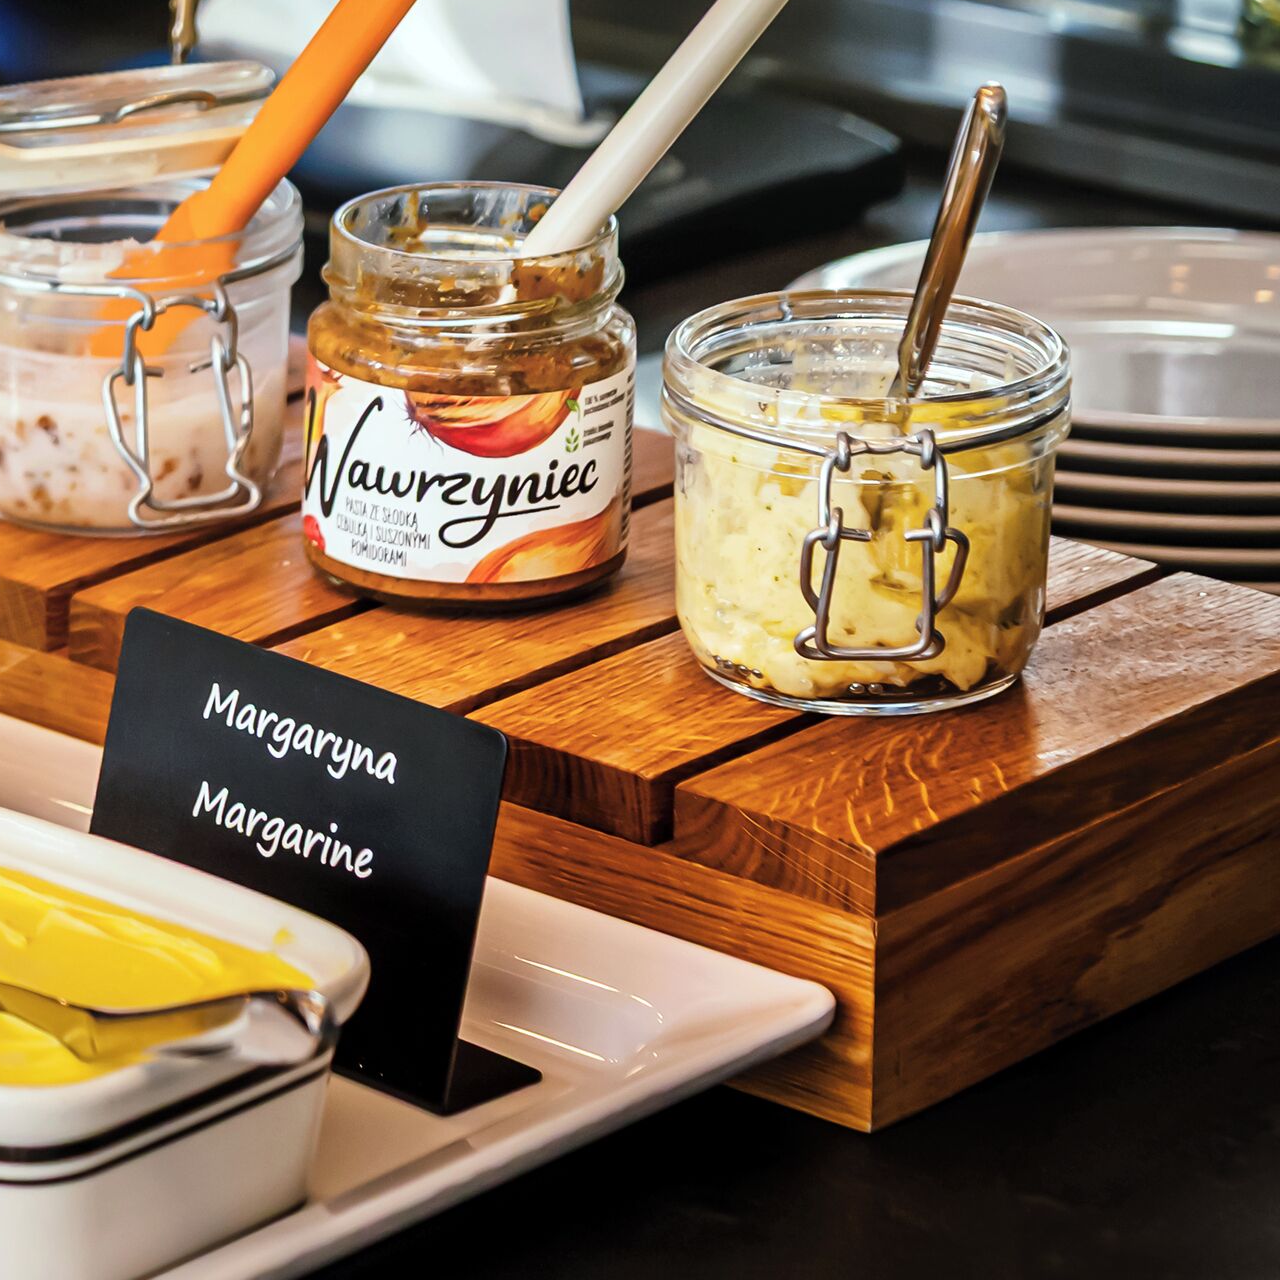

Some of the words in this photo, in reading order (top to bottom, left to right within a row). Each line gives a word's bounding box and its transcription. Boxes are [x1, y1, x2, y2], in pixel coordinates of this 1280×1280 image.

[304, 386, 599, 549] Wawrzyniec
[202, 682, 397, 784] Margaryna
[192, 780, 374, 879] Margarine
